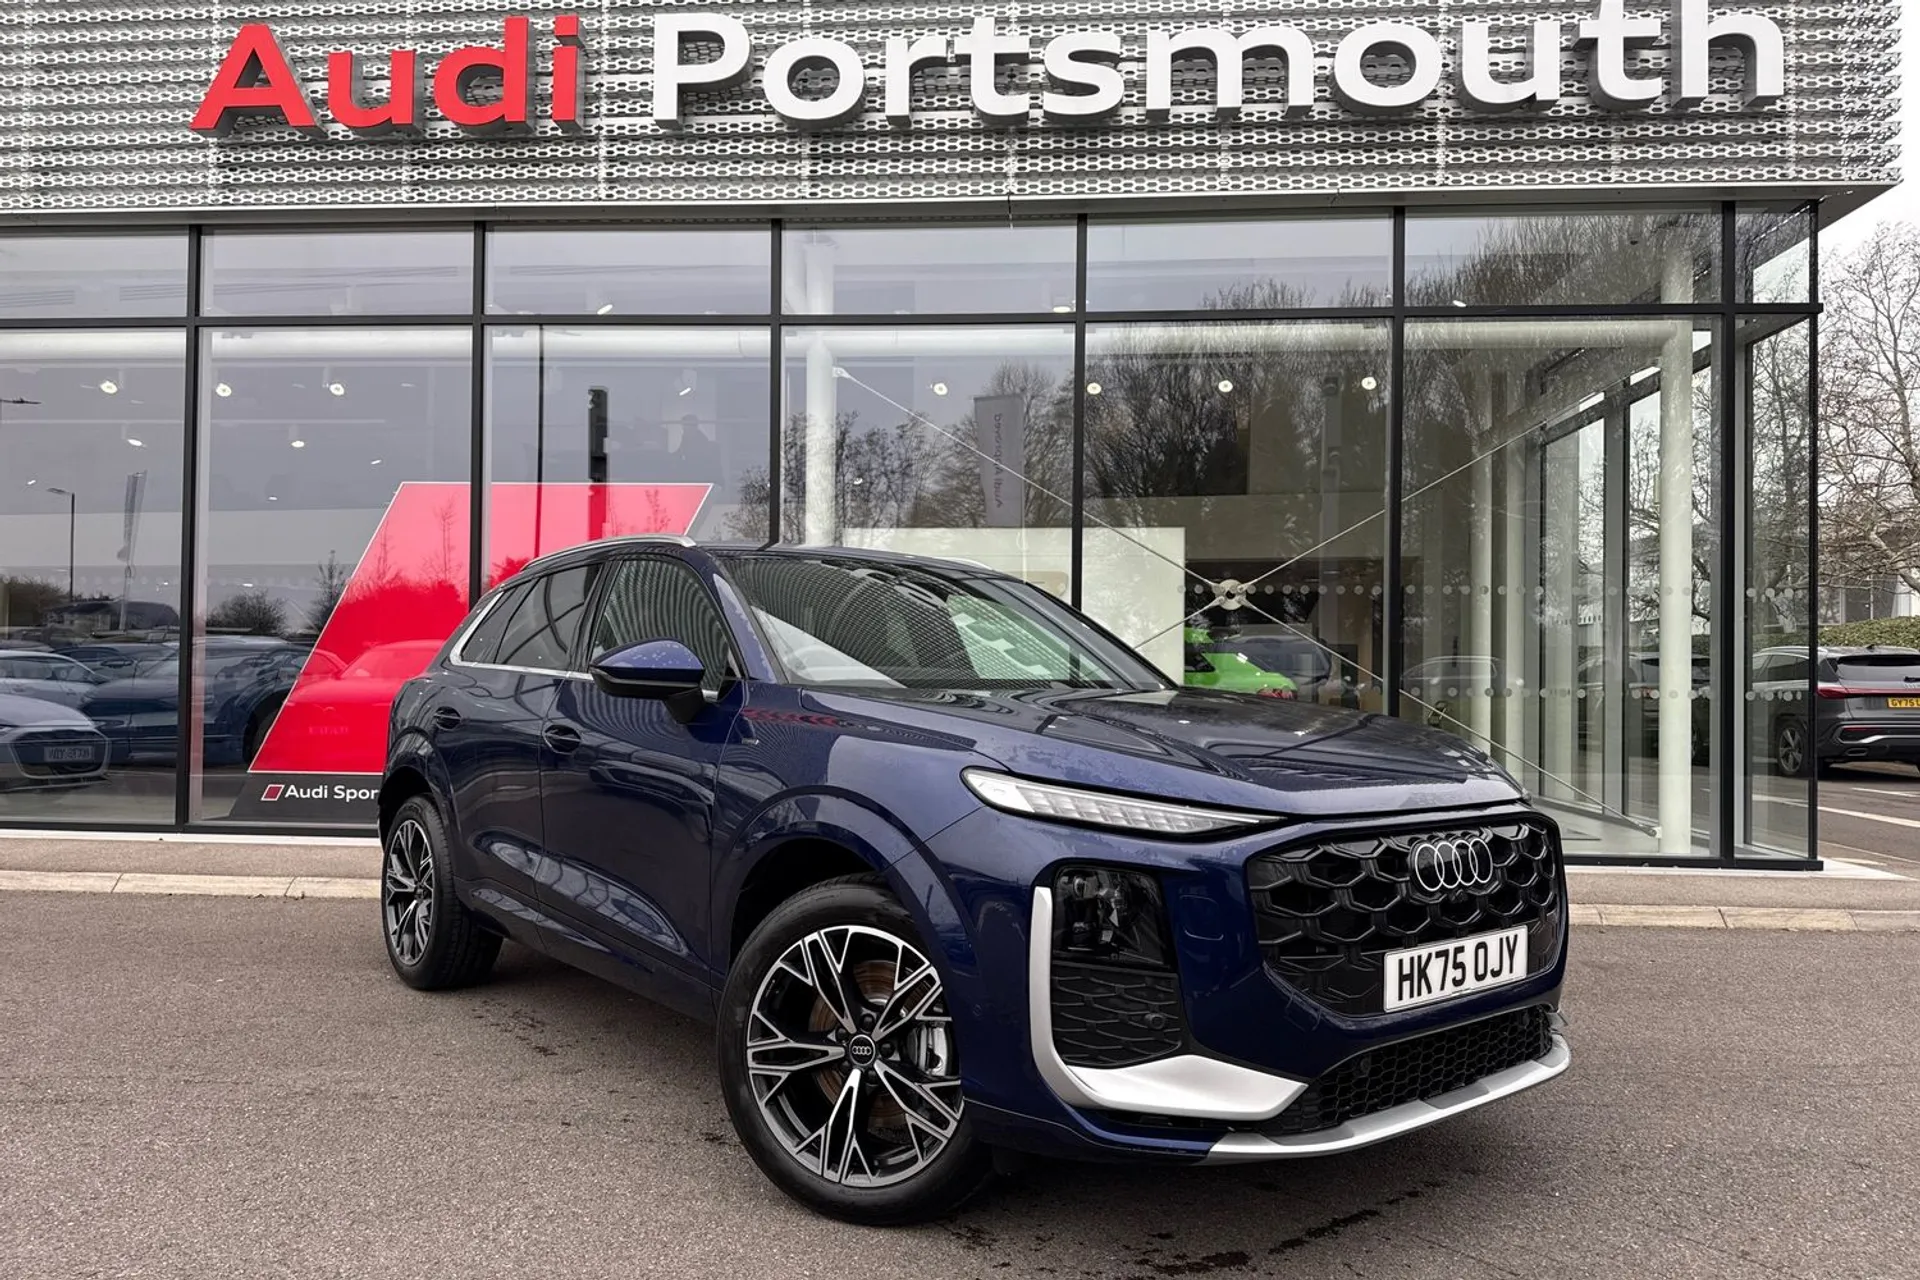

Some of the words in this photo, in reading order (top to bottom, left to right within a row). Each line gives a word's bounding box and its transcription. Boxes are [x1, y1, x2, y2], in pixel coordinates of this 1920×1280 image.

[191, 16, 582, 129] Audi
[652, 0, 1784, 124] Portsmouth
[286, 785, 328, 799] Audi
[333, 785, 379, 802] Spor
[1398, 945, 1467, 1001] HK75
